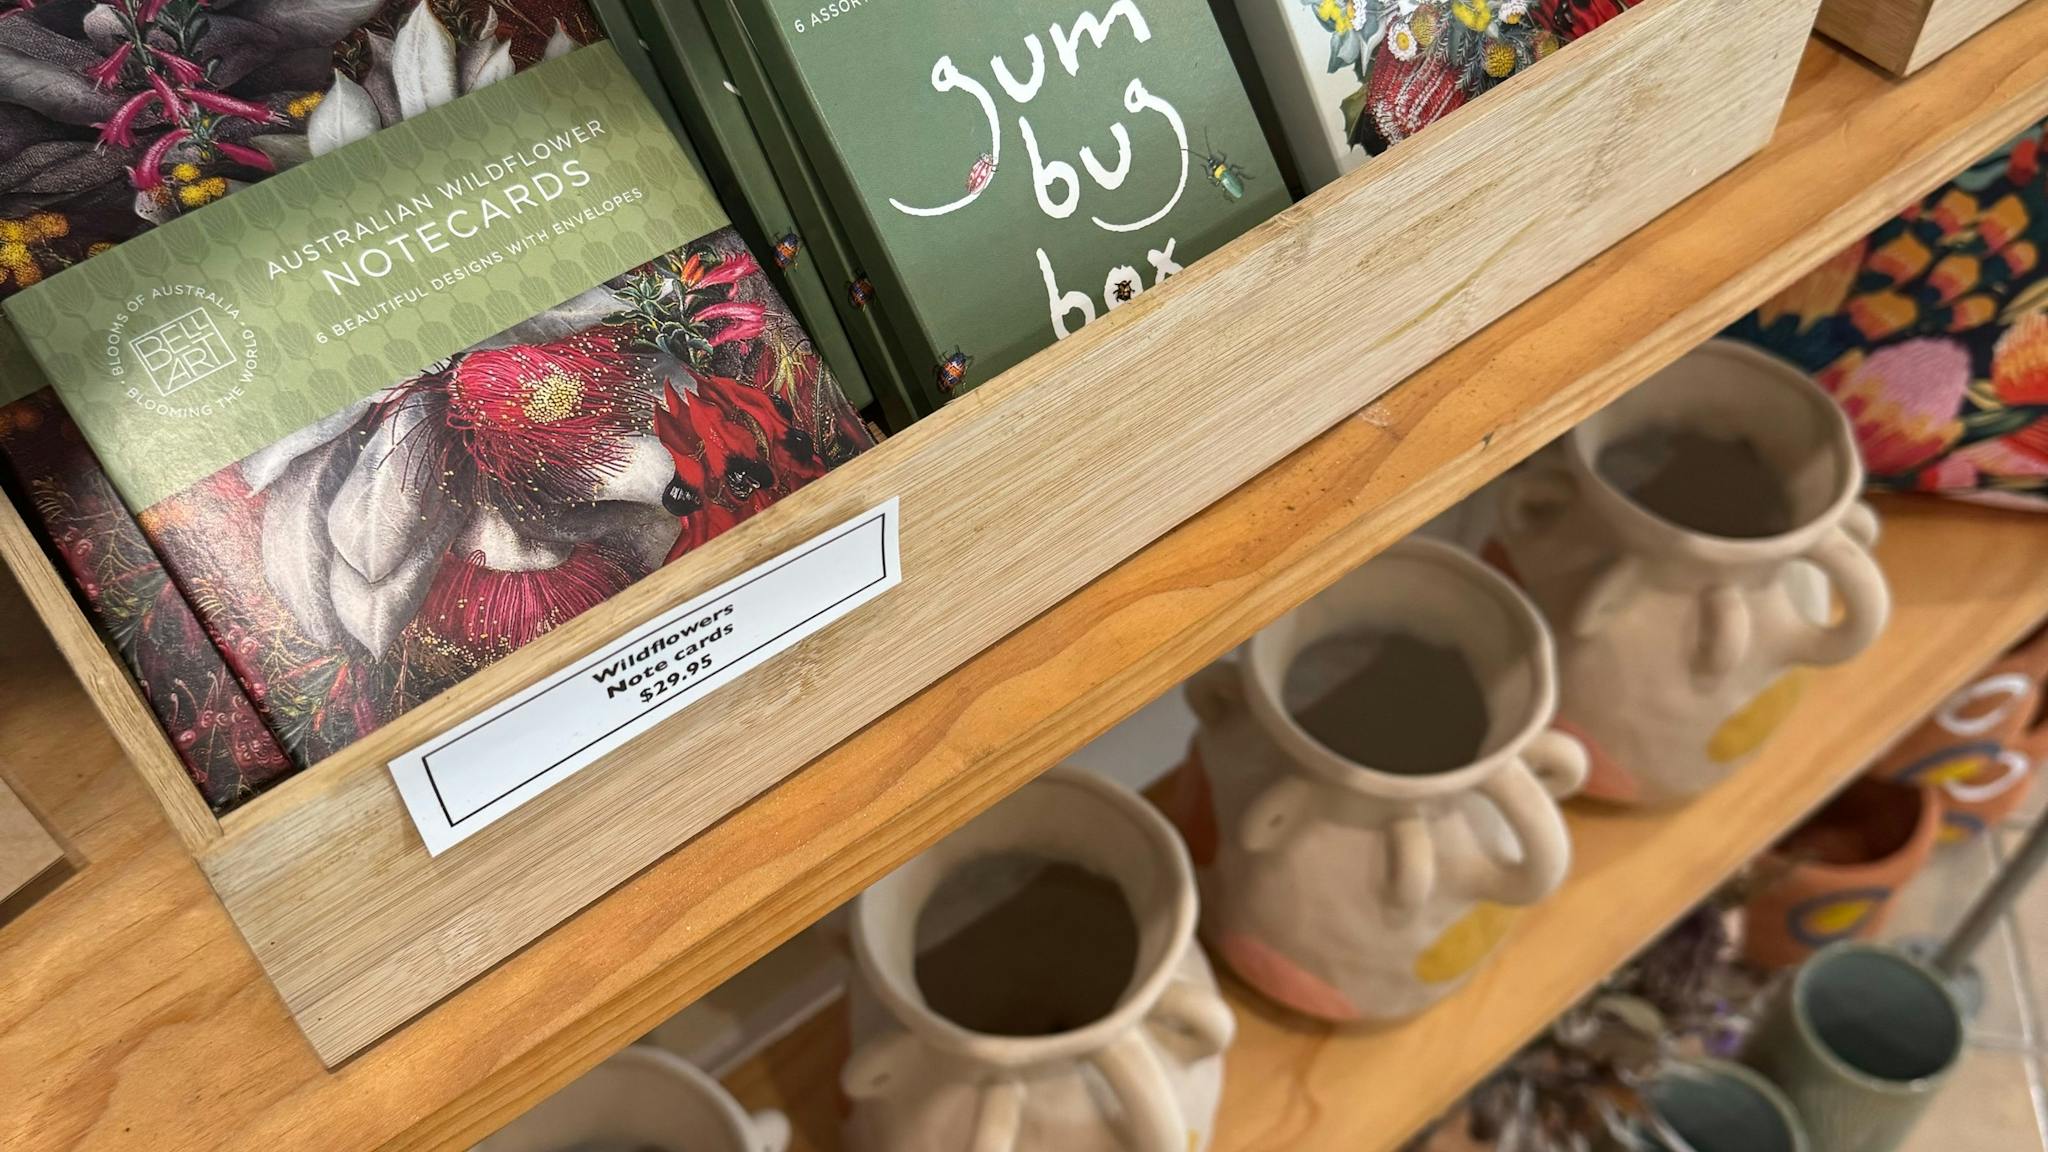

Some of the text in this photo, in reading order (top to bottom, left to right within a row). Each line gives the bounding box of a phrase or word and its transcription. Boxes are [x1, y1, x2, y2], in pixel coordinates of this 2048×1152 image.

[794, 0, 869, 33] 6 ASSOR
[889, 0, 1152, 217] gum
[1018, 77, 1189, 233] bug
[268, 119, 606, 281] AUSTRALIAN WILDFLOWER
[322, 159, 591, 296] NOTECARDS
[316, 187, 644, 344] 6 BEAUTIFUL DESIGNS WITH ENVELOPES
[1036, 237, 1184, 341] box
[107, 284, 240, 377] BLOOMS OF AUSTRALIA
[126, 329, 258, 418] BLOOMING THE WORLD
[592, 603, 734, 684] Wildflowers
[606, 623, 734, 699] Note cards
[639, 653, 713, 703] $29.95
